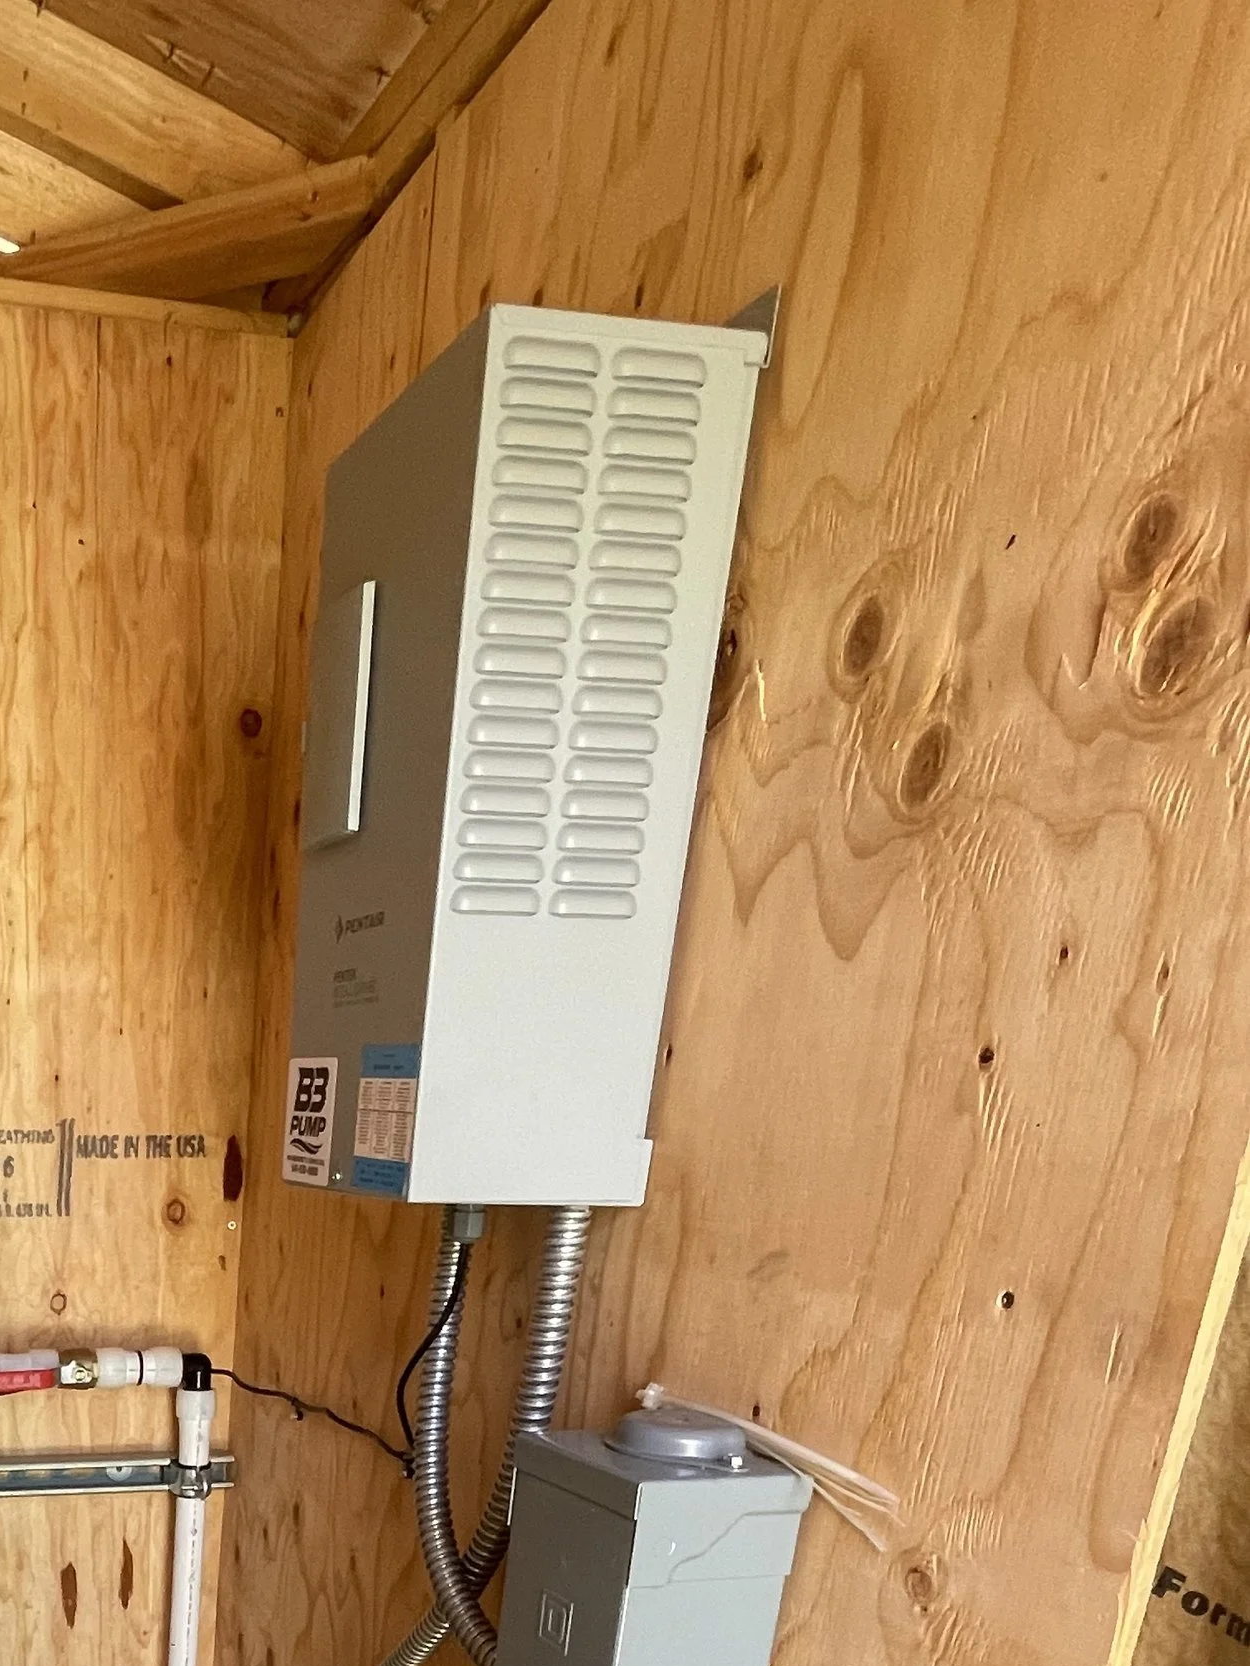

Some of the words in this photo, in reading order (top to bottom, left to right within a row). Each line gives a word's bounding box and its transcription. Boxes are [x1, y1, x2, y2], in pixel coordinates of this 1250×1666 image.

[293, 1067, 330, 1113] B3
[289, 1115, 327, 1138] PUMP
[76, 1134, 119, 1159] MADE
[124, 1134, 140, 1159] IN
[145, 1134, 172, 1159] THE
[176, 1133, 207, 1159] USA
